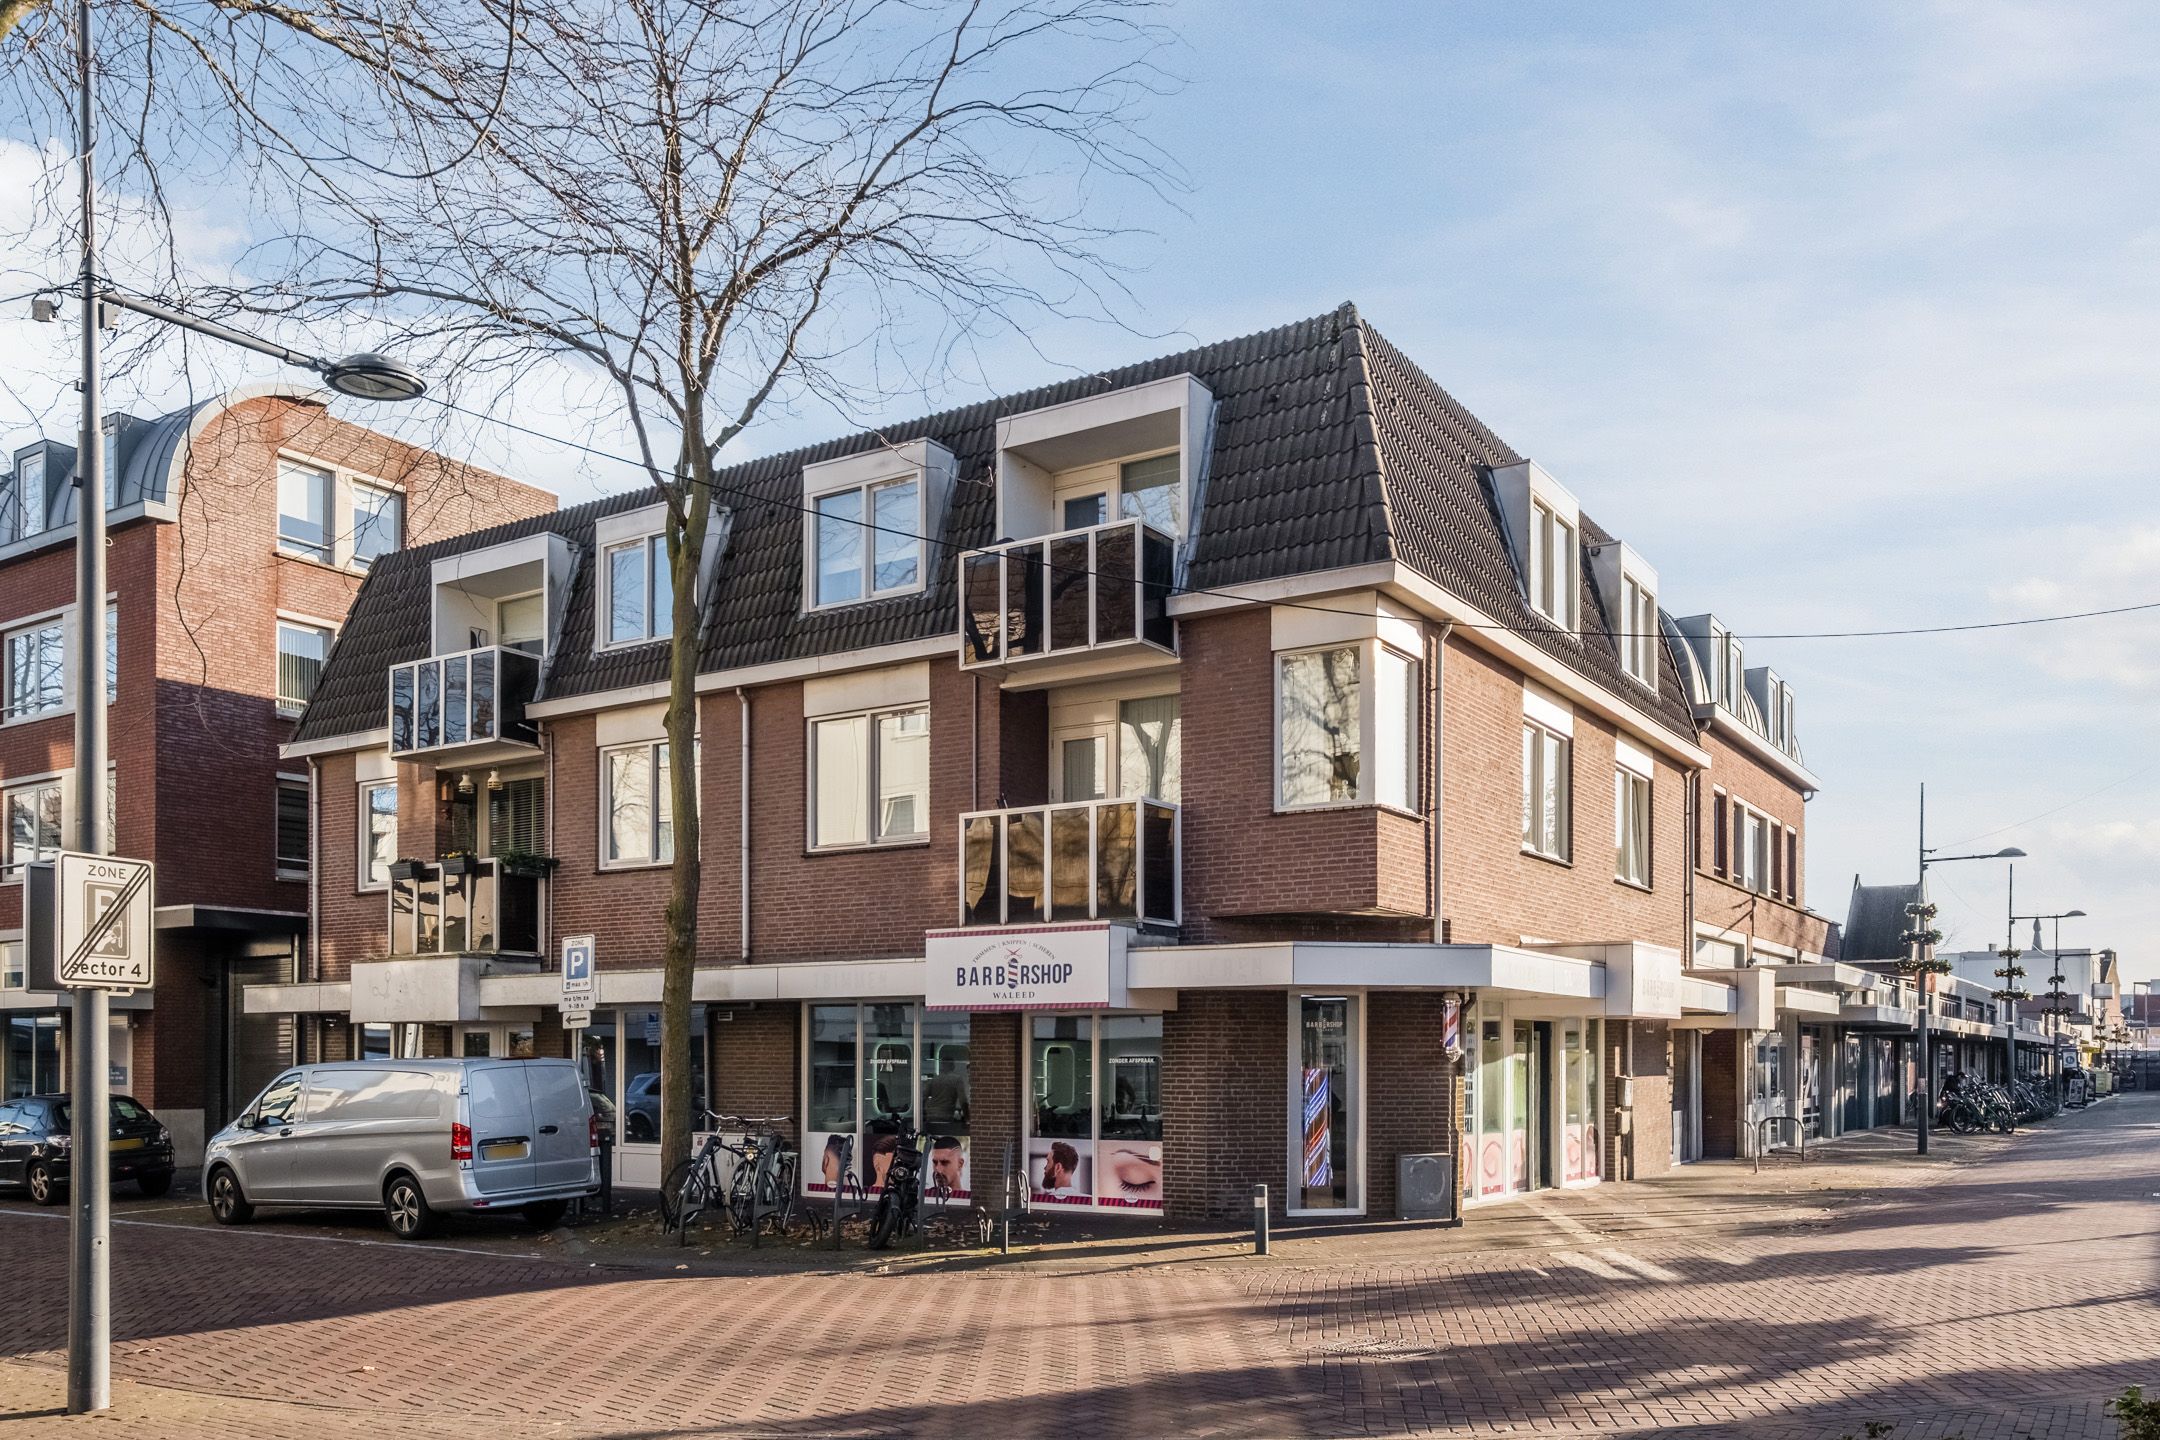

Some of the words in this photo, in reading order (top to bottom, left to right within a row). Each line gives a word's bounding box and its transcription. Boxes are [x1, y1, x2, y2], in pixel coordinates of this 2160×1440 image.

[88, 865, 127, 879] ZONE
[973, 944, 996, 963] TRIMMEN
[1002, 939, 1027, 947] KNIPPEN
[1033, 943, 1055, 960] SCHEREN
[131, 963, 142, 978] 4
[571, 951, 584, 976] P
[993, 991, 1036, 999] WALEED
